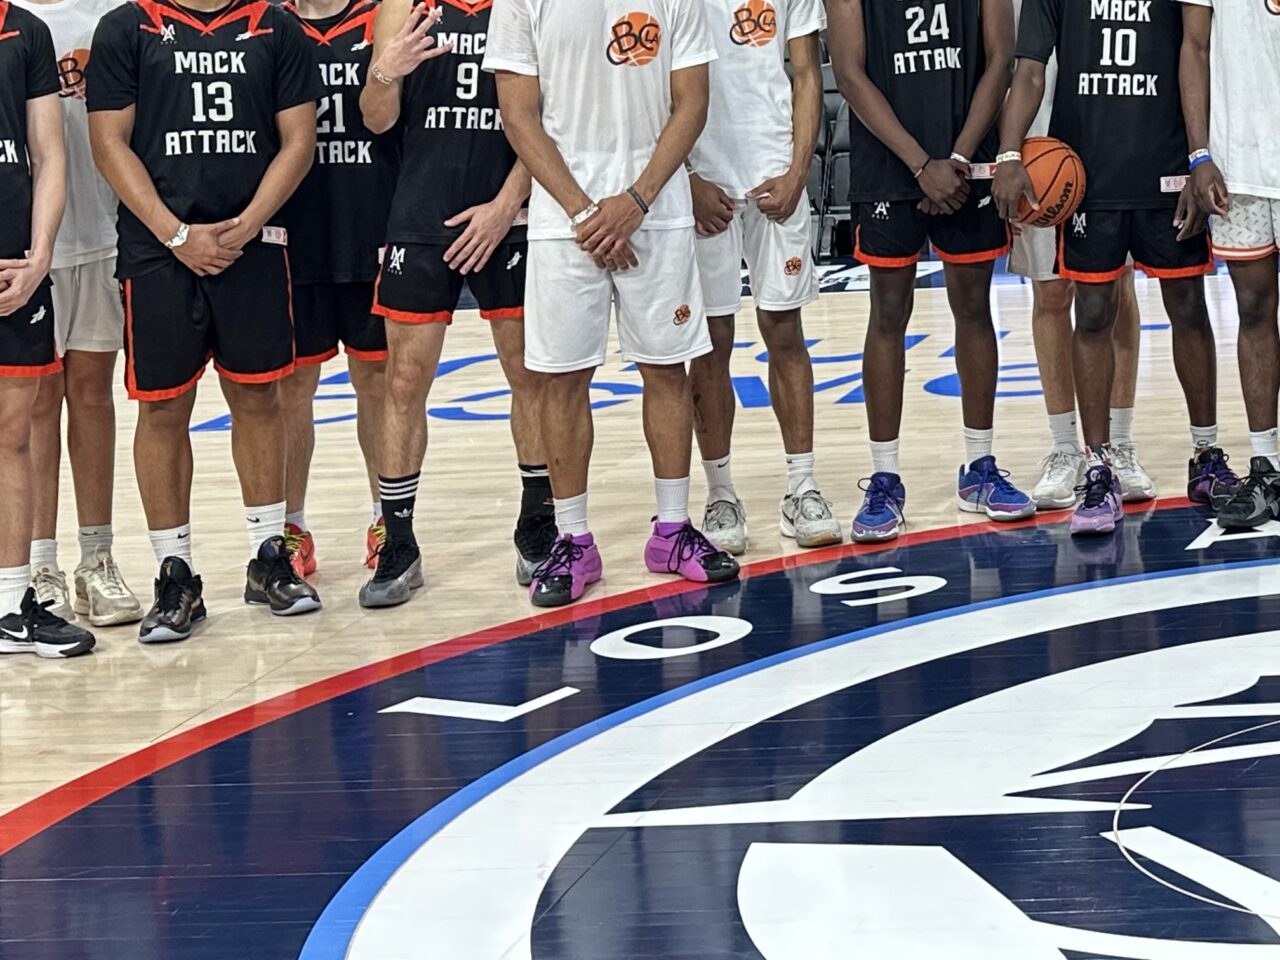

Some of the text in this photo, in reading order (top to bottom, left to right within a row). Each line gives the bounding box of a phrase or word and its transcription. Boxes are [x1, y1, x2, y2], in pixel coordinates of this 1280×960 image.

[904, 2, 950, 44] 24
[173, 50, 247, 75] MACK
[1100, 27, 1137, 67] 10
[456, 62, 479, 100] 9
[1078, 72, 1159, 96] ATTACK
[191, 81, 234, 122] 13
[165, 129, 257, 156] ATTACK
[379, 566, 947, 723] LOS
